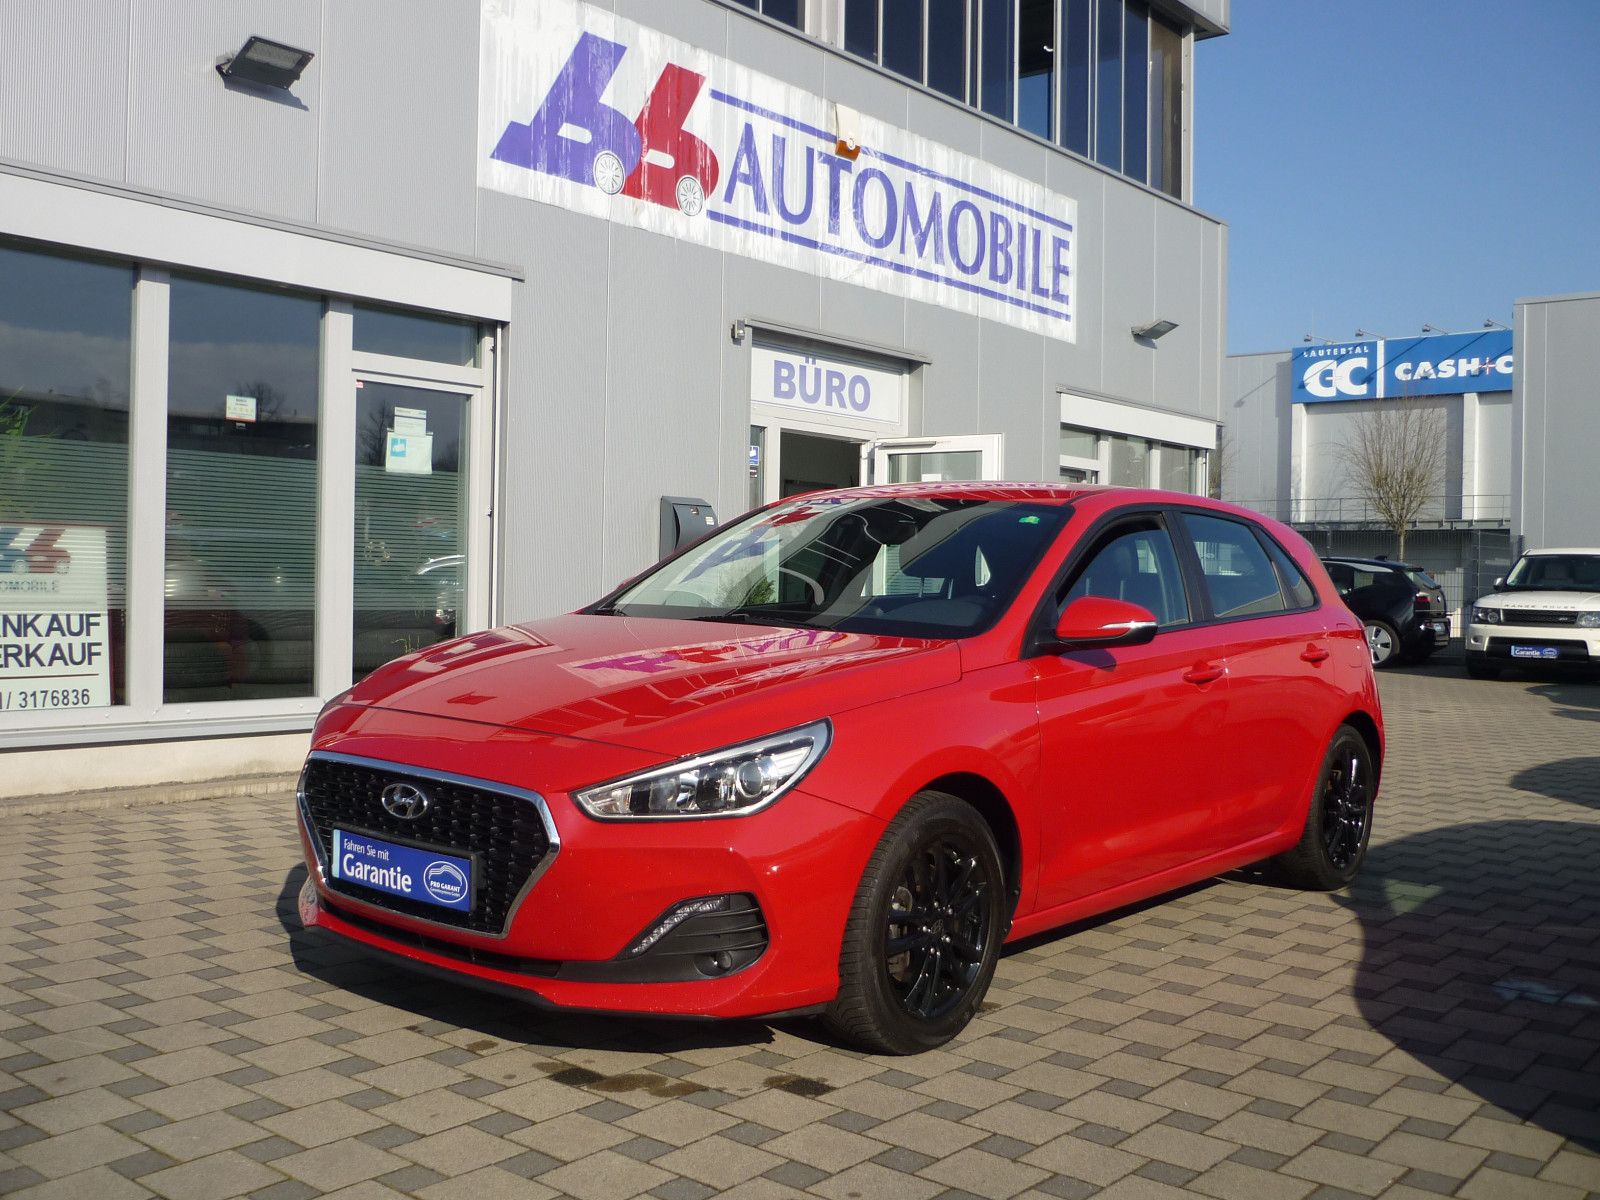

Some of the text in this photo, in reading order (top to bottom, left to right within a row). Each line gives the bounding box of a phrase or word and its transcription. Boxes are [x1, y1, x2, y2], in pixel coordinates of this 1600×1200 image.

[724, 122, 1071, 306] AUTOMOBILE
[1303, 345, 1369, 358] LAUTERTAL
[773, 356, 871, 412] BÜRO
[0, 613, 101, 637] NKAUF
[0, 642, 102, 668] RKAUF
[19, 688, 90, 709] 3176836
[344, 838, 390, 861] Fahren Sie mit
[343, 853, 412, 893] Garantie
